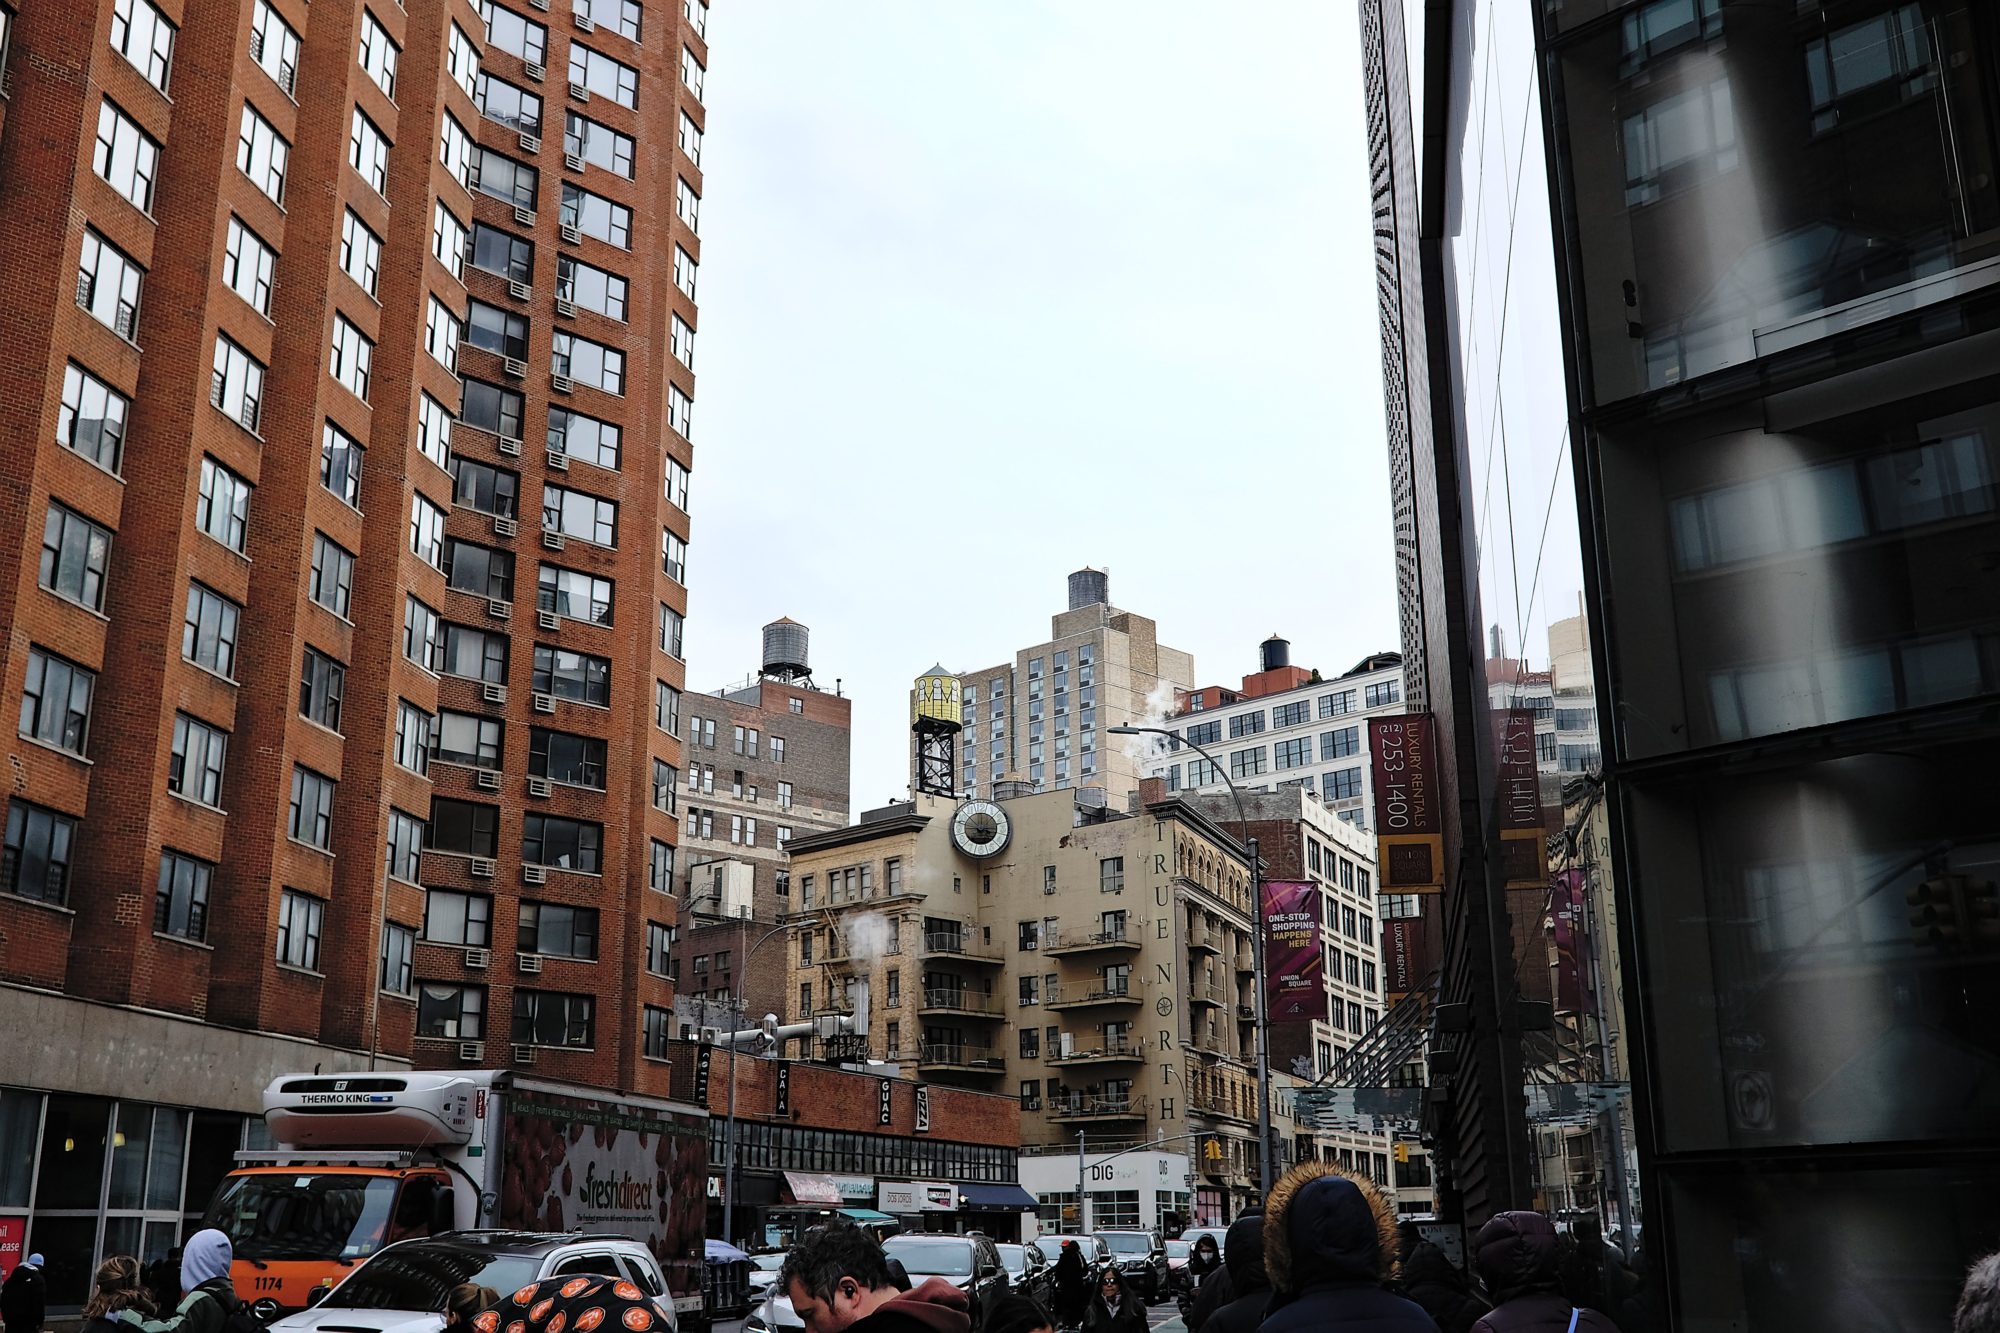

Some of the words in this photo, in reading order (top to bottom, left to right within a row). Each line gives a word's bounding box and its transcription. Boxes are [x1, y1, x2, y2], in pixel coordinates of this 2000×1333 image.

[1379, 723, 1403, 735] (212)
[1406, 722, 1422, 770] LUXURY
[1381, 736, 1409, 828] 253-1400
[1411, 773, 1426, 827] RENTALS
[1153, 821, 1169, 939] TRUE
[1268, 912, 1311, 923] ONE-STOP
[1272, 921, 1315, 931] SHOPPING
[1273, 930, 1312, 940] HAPPENS
[1393, 922, 1404, 954] LUXURY
[1288, 939, 1311, 948] HERE
[1280, 974, 1299, 982] UNION
[1396, 954, 1406, 988] RENTALS
[779, 1069, 787, 1110] CAVA
[301, 1094, 342, 1104] THERMO
[345, 1093, 370, 1103] KING
[882, 1081, 890, 1123] GUAC
[917, 1090, 928, 1127] PIZZA
[1092, 1165, 1113, 1181] DIG
[1158, 1159, 1168, 1175] DIG
[255, 1276, 283, 1291] 1174
